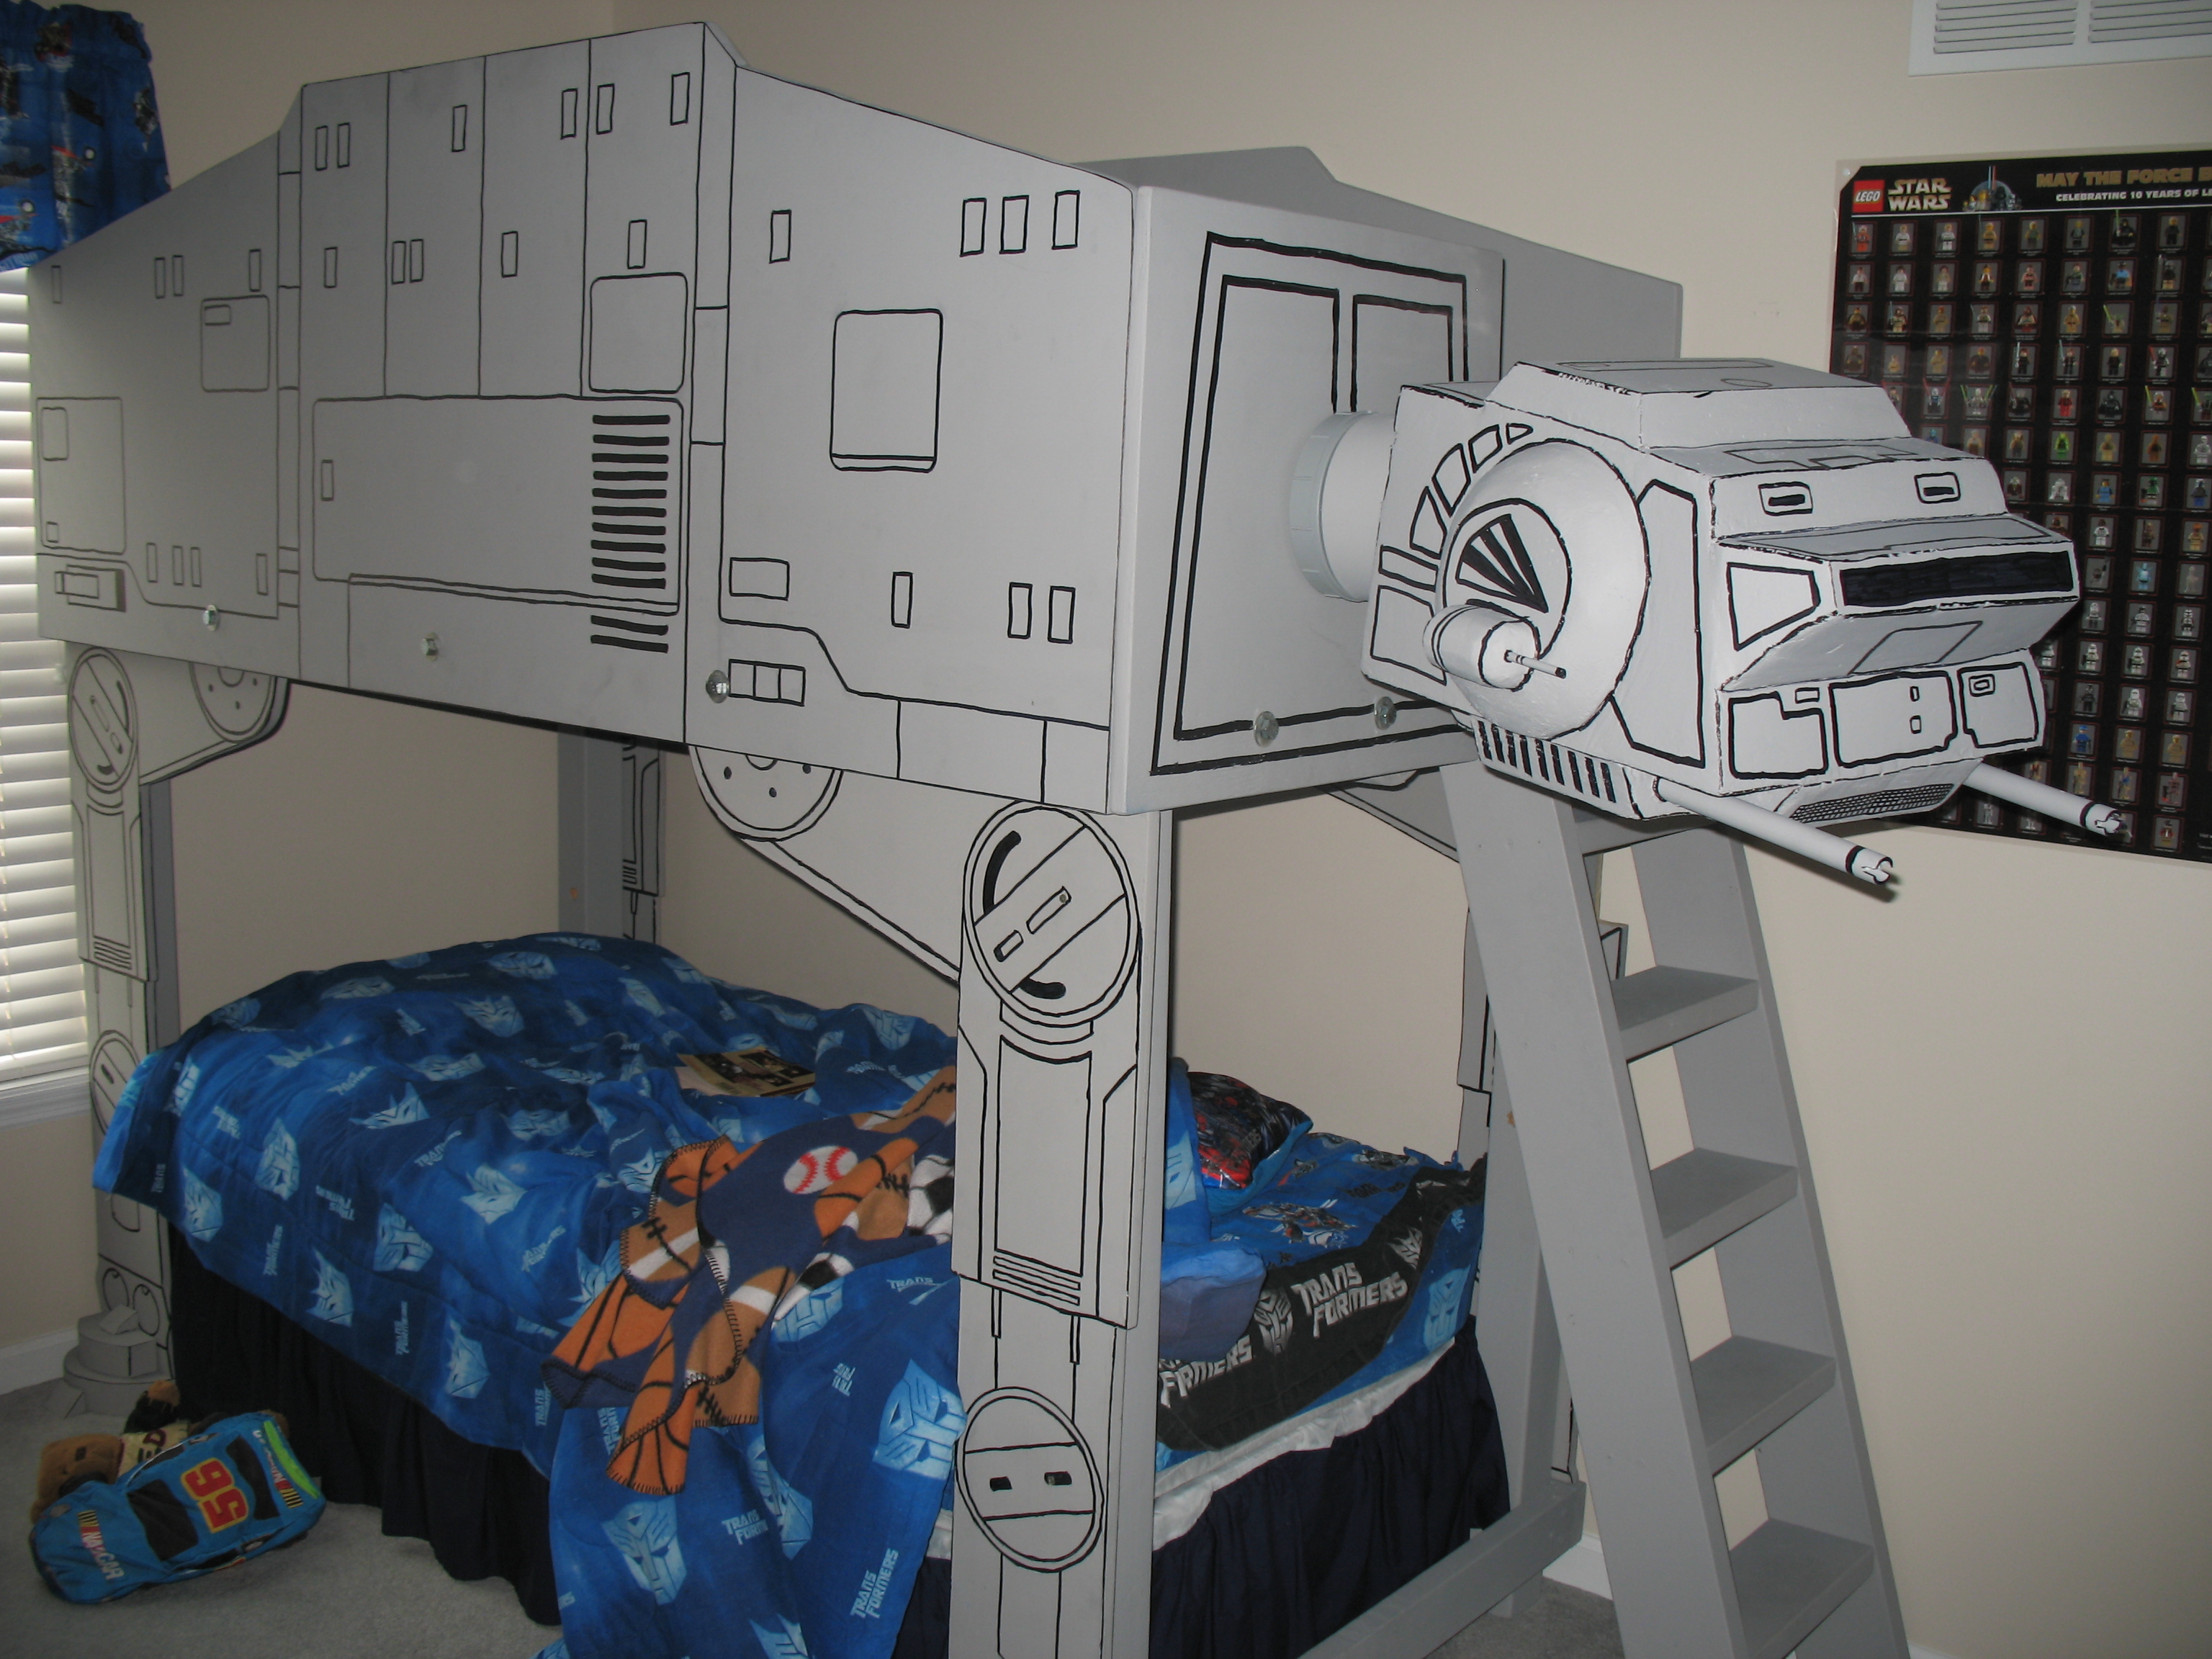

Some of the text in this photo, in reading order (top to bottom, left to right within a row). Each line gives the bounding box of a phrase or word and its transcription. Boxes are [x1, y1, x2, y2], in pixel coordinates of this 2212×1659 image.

[1888, 178, 1952, 194] STAR
[2036, 172, 2080, 187] MAY
[2084, 170, 2122, 186] THE
[2126, 167, 2193, 184] FORCE
[1855, 190, 1881, 202] LEGO
[1888, 194, 1951, 211] WARS
[2056, 191, 2126, 202] CELEBRATING
[2131, 190, 2143, 199] 10
[2146, 189, 2182, 199] YEARS
[2184, 189, 2200, 198] OF
[1290, 1262, 1362, 1316] TRANS
[1313, 1272, 1408, 1339] FORMERS
[865, 1548, 899, 1619] FORMERS
[850, 1570, 877, 1619] TRANS
